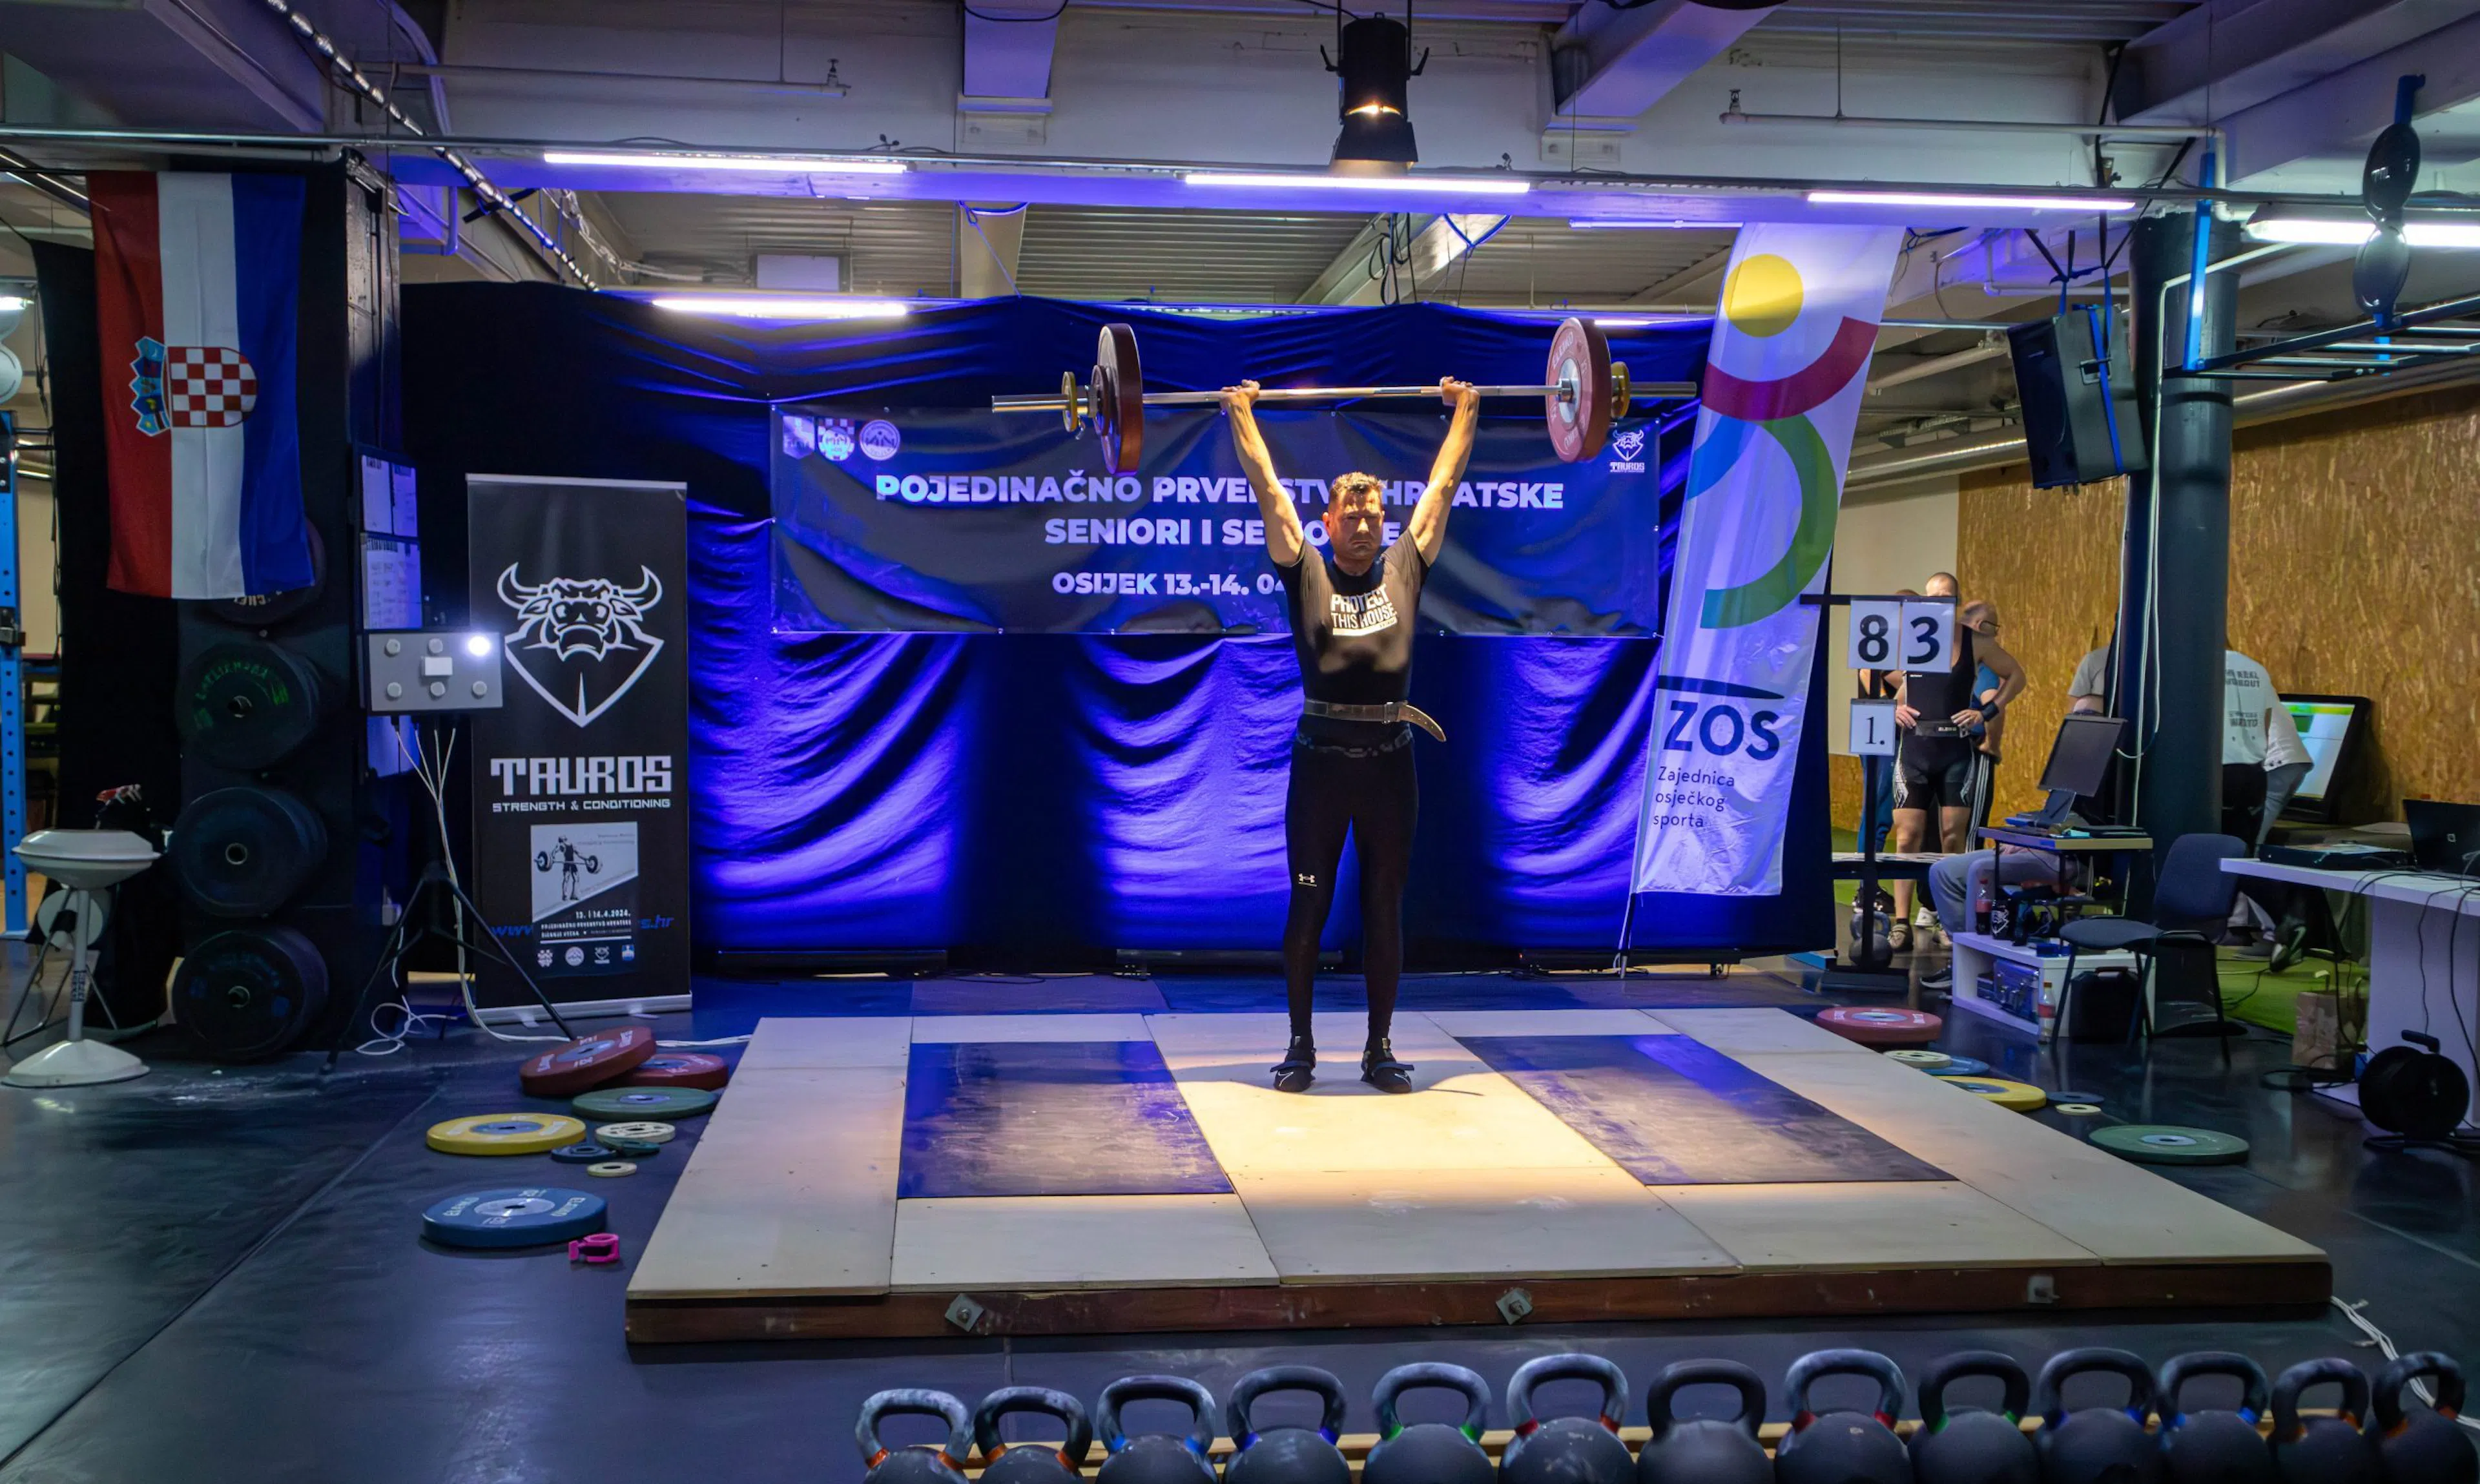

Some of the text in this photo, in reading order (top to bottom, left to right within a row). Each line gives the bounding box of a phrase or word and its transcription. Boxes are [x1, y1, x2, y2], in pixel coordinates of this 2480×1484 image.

[1610, 462, 1645, 471] TAUROS
[876, 469, 1142, 502] POJEDINAČNO
[1383, 480, 1564, 509] HRATSKE
[1045, 519, 1190, 545] SENIORI
[1202, 519, 1212, 544] I
[1052, 572, 1157, 595] OSIJEK
[1164, 573, 1250, 595] 13.-14.
[1332, 583, 1389, 613] PROTECT
[1331, 612, 1359, 628] THIS
[1663, 700, 1780, 761] ZOS
[1865, 716, 1885, 745] 1.
[490, 756, 672, 796] TAUROS
[1658, 766, 1735, 787] Zajednica
[492, 798, 671, 812] STRENGTH & CONDITIONING
[1655, 790, 1725, 812] osječkog
[1653, 813, 1704, 830] sporta
